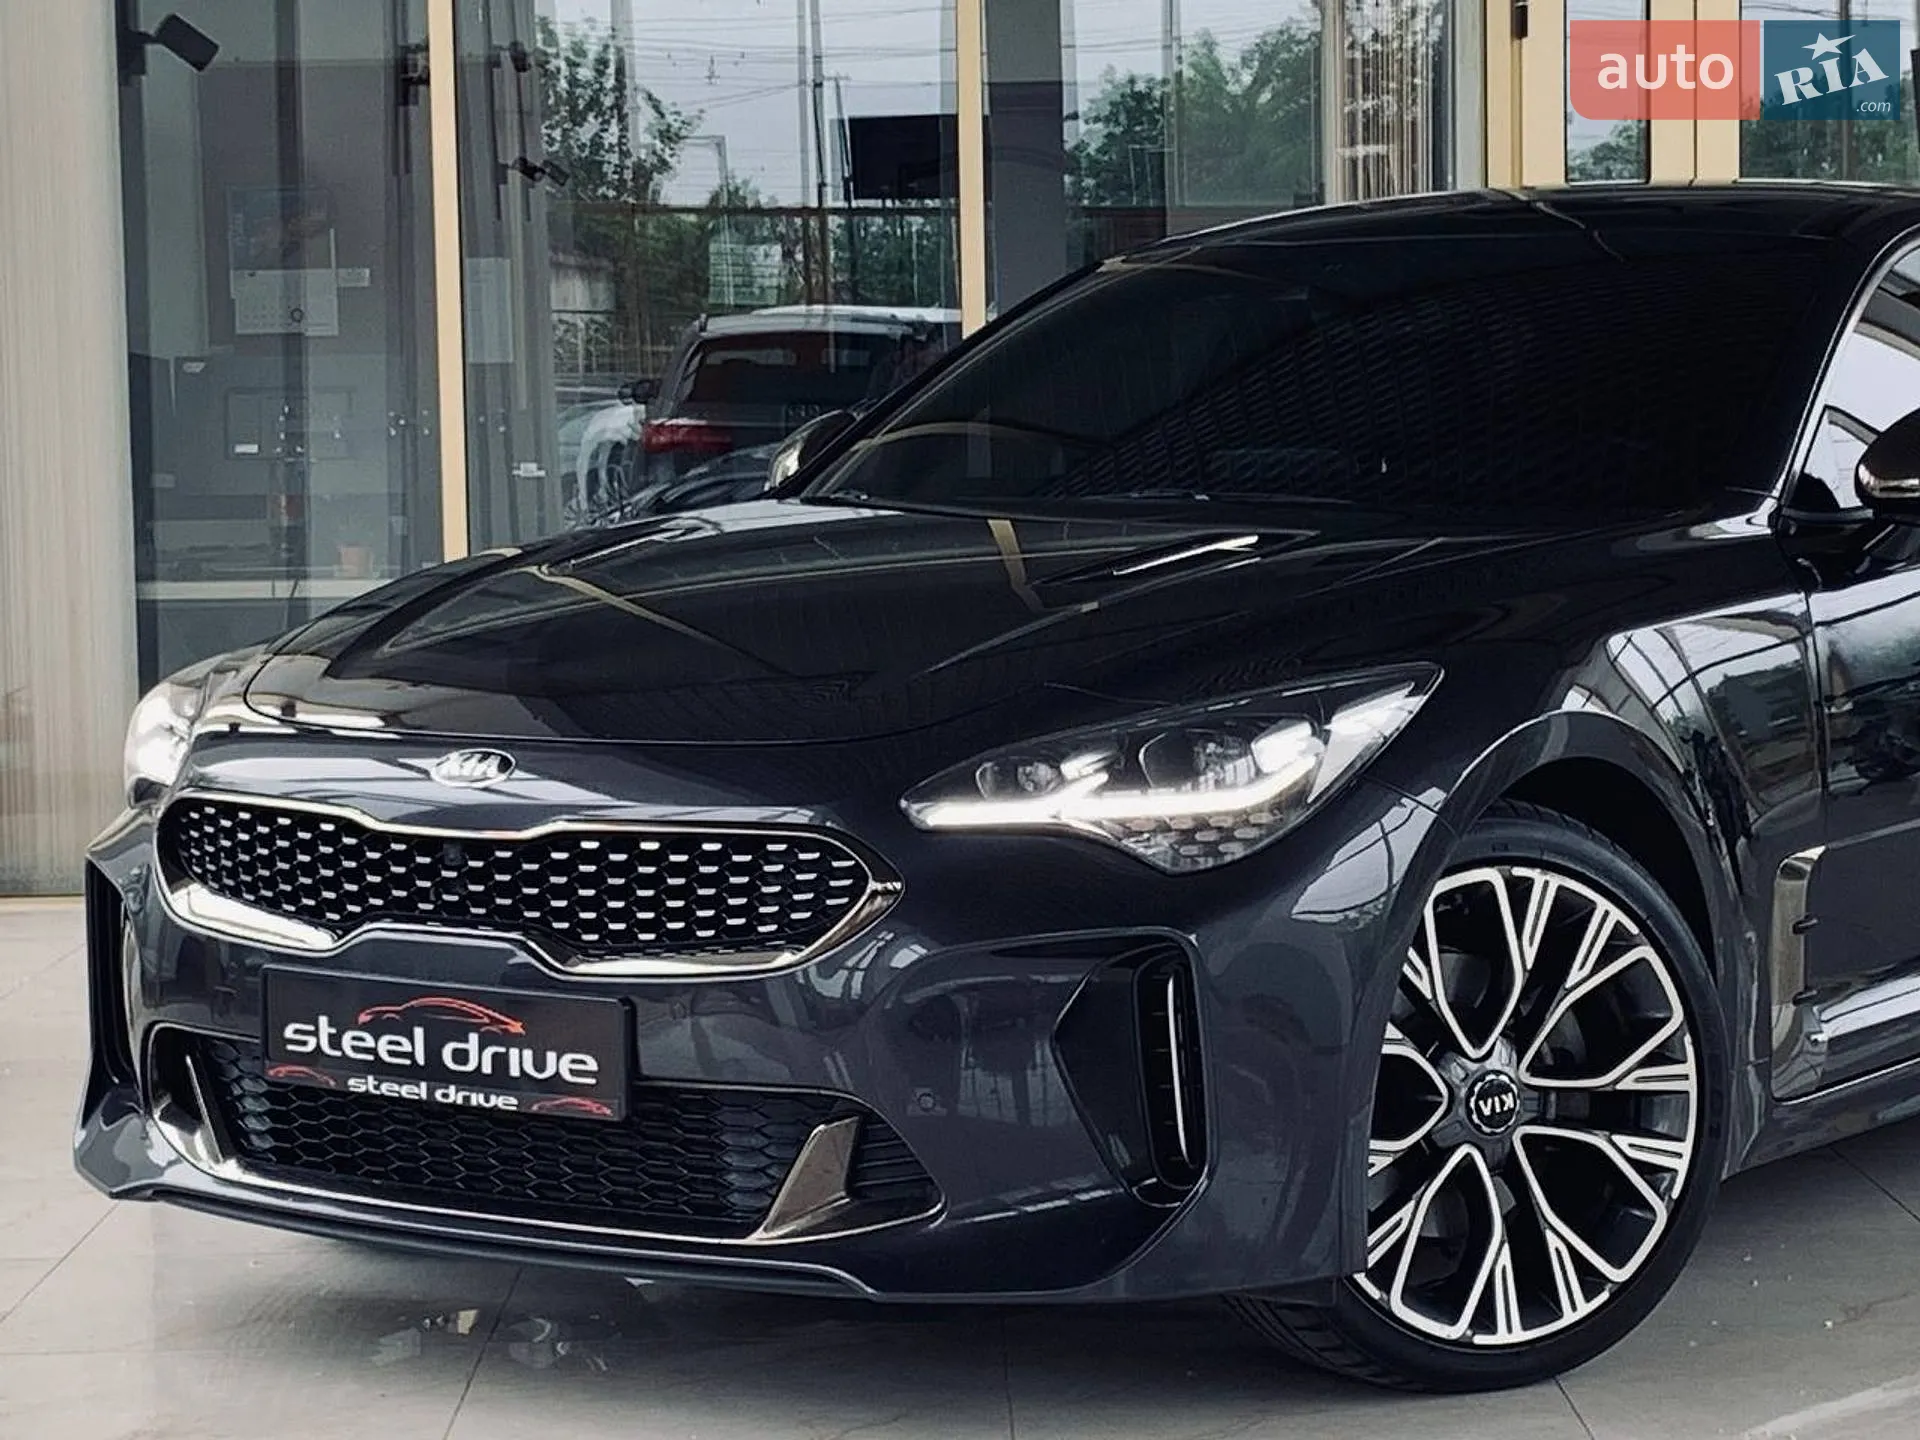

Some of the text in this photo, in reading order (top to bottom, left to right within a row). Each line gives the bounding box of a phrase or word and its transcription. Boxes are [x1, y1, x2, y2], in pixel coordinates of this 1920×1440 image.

[283, 1015, 598, 1085] steel drive
[347, 1074, 519, 1110] steel drive
